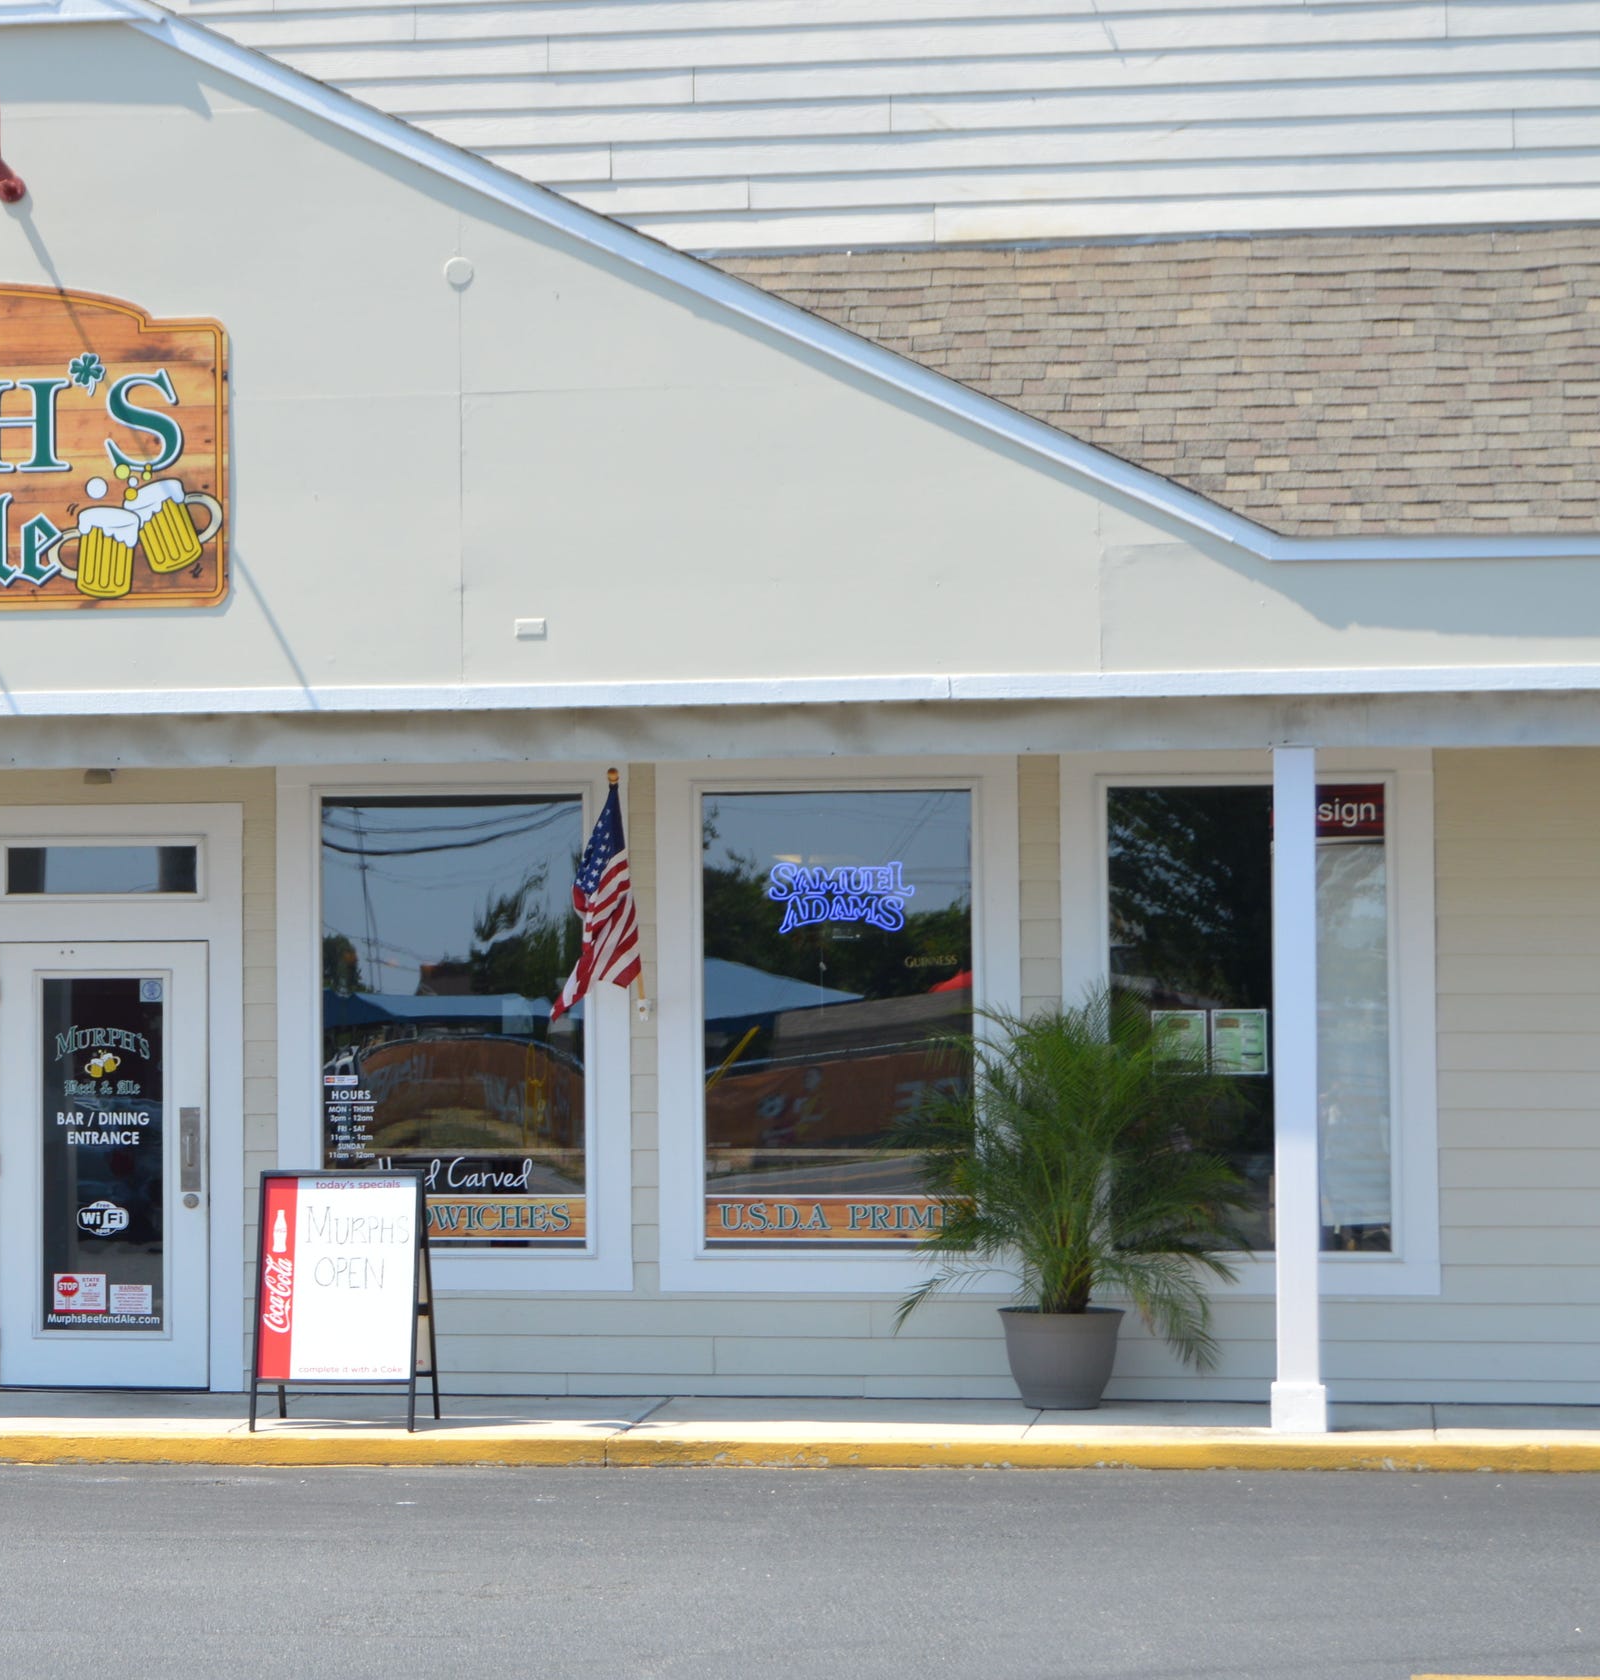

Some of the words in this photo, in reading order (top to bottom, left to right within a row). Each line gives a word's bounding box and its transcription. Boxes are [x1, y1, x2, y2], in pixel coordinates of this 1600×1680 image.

[768, 861, 916, 900] SAMUEL
[778, 895, 905, 934] ADAMS
[331, 1090, 371, 1100] HOURS
[56, 1112, 84, 1125] BAR
[98, 1112, 150, 1125] DINING
[67, 1132, 140, 1145] ENTRANCE
[447, 1156, 533, 1190] Carved
[315, 1180, 355, 1190] today's
[358, 1180, 401, 1189] specials
[427, 1204, 571, 1232] WICHES
[305, 1206, 410, 1244] MURPHS
[314, 1257, 385, 1290] OPEN
[58, 1282, 78, 1291] STOP
[47, 1314, 160, 1325] MurphsBeefandAle.com
[298, 1366, 339, 1374] complete
